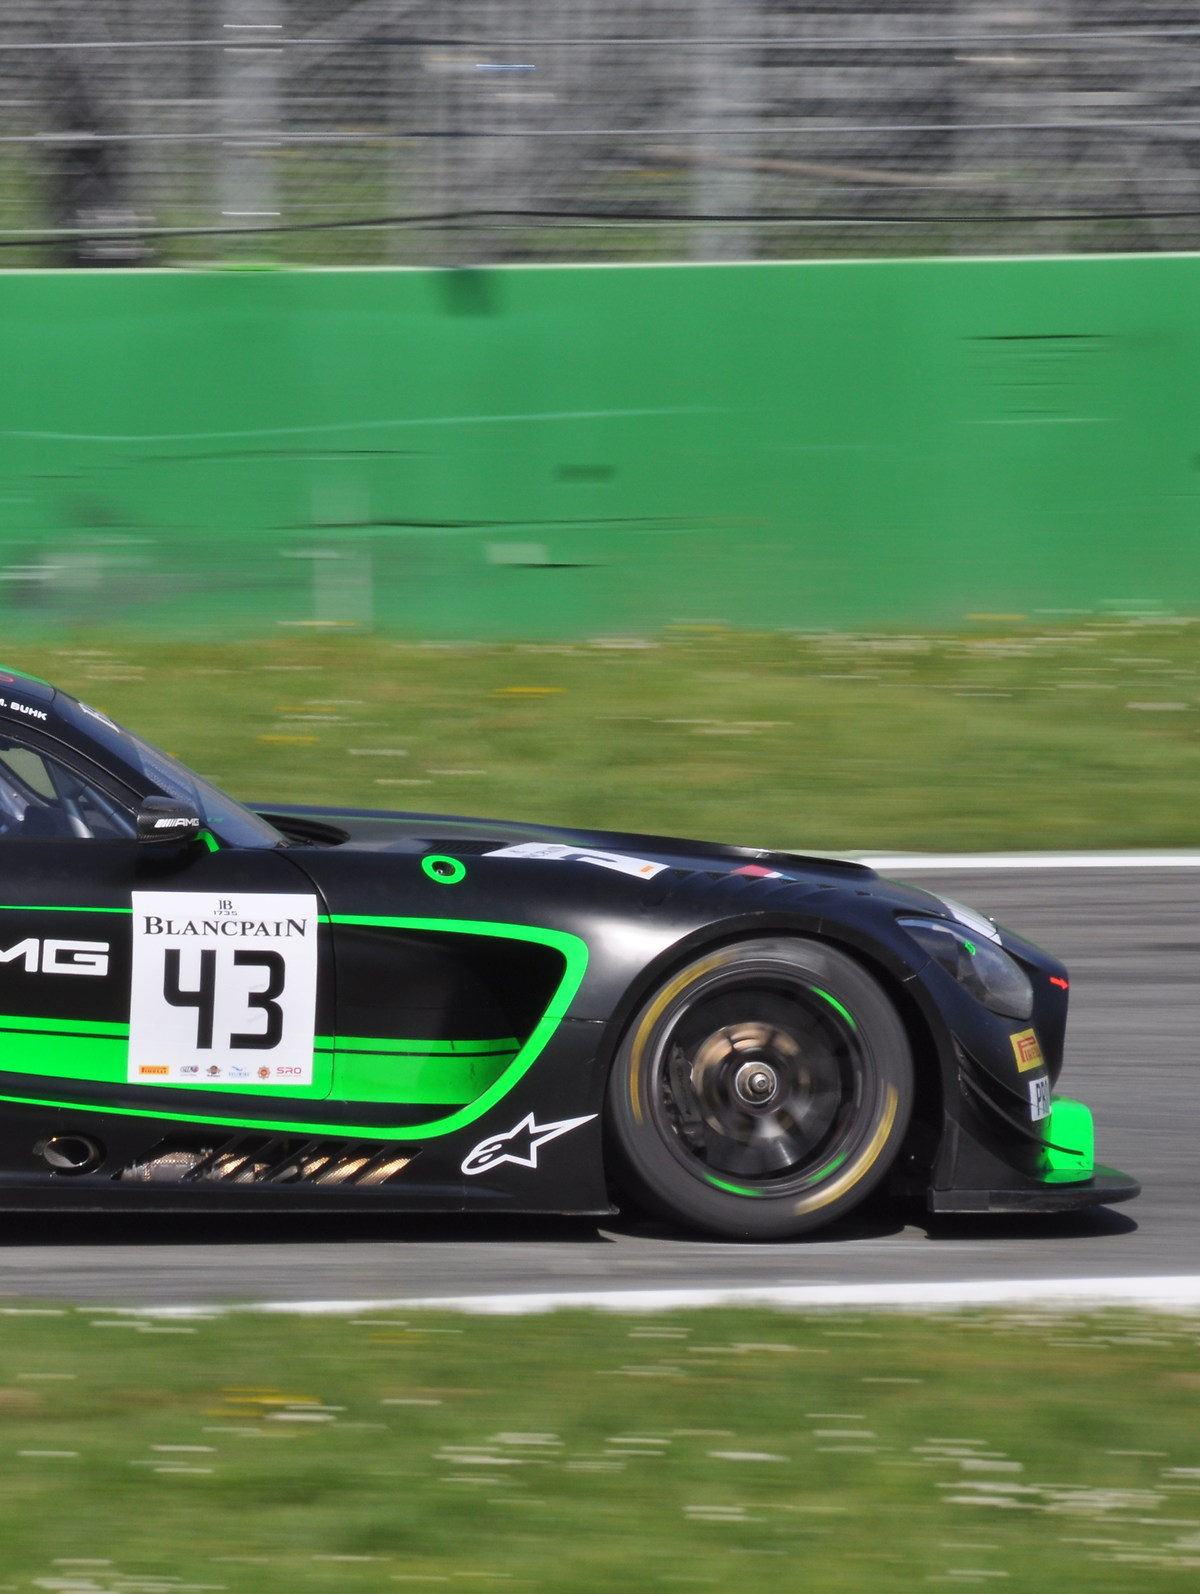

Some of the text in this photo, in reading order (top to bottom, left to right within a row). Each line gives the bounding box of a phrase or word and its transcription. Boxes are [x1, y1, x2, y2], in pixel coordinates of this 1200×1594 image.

[10, 702, 47, 721] BUHK
[174, 818, 199, 826] AMG
[143, 915, 307, 937] BLANCPAIN
[163, 948, 286, 1050] 43
[276, 1066, 302, 1074] SRO
